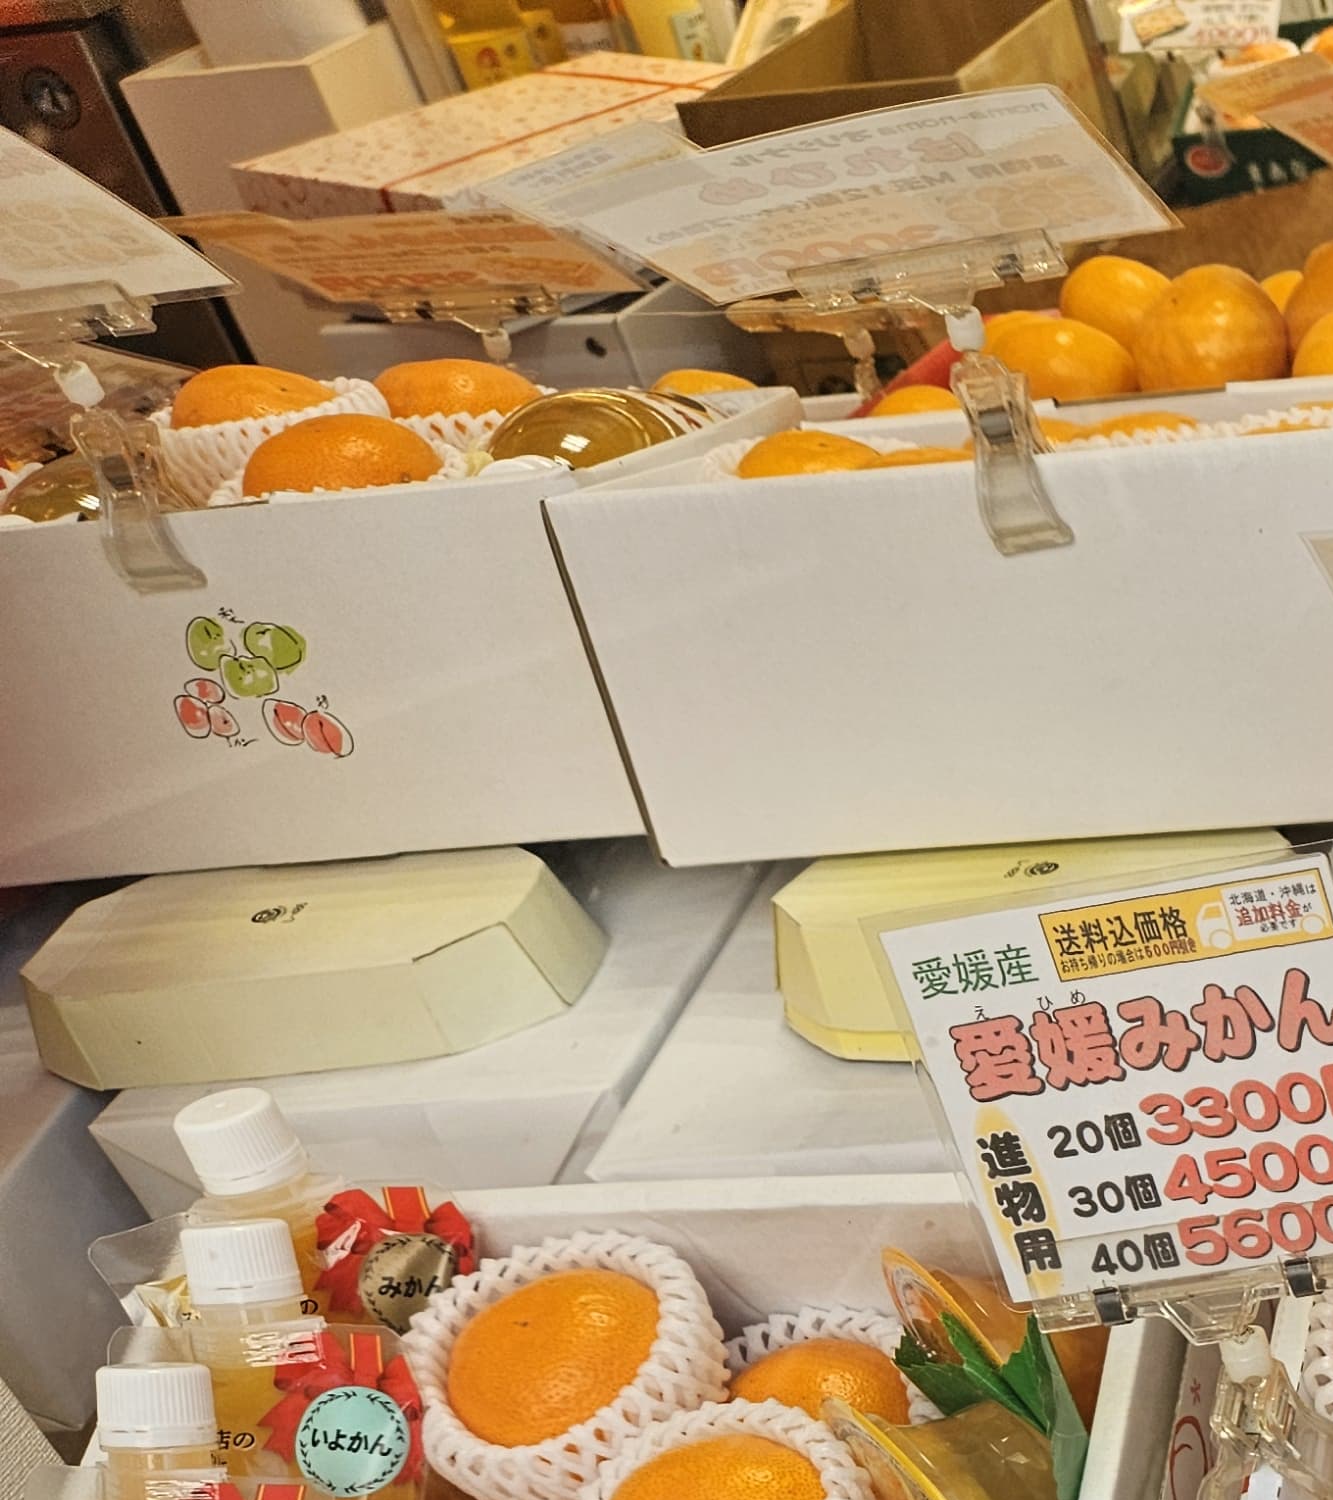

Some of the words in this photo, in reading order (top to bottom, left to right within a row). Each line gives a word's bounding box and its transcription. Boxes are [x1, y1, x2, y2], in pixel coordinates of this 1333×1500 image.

[1228, 882, 1318, 908] 北海道・沖縄は
[1235, 899, 1314, 929] 追加料金が
[1053, 906, 1190, 958] 送料込価格
[911, 943, 1041, 1001] 愛媛産
[1046, 1111, 1144, 1161] 20個
[975, 1130, 1065, 1276] 進物用
[1066, 1171, 1164, 1219] 30個
[1089, 1230, 1182, 1277] 40個
[310, 1427, 394, 1458] いよかん
